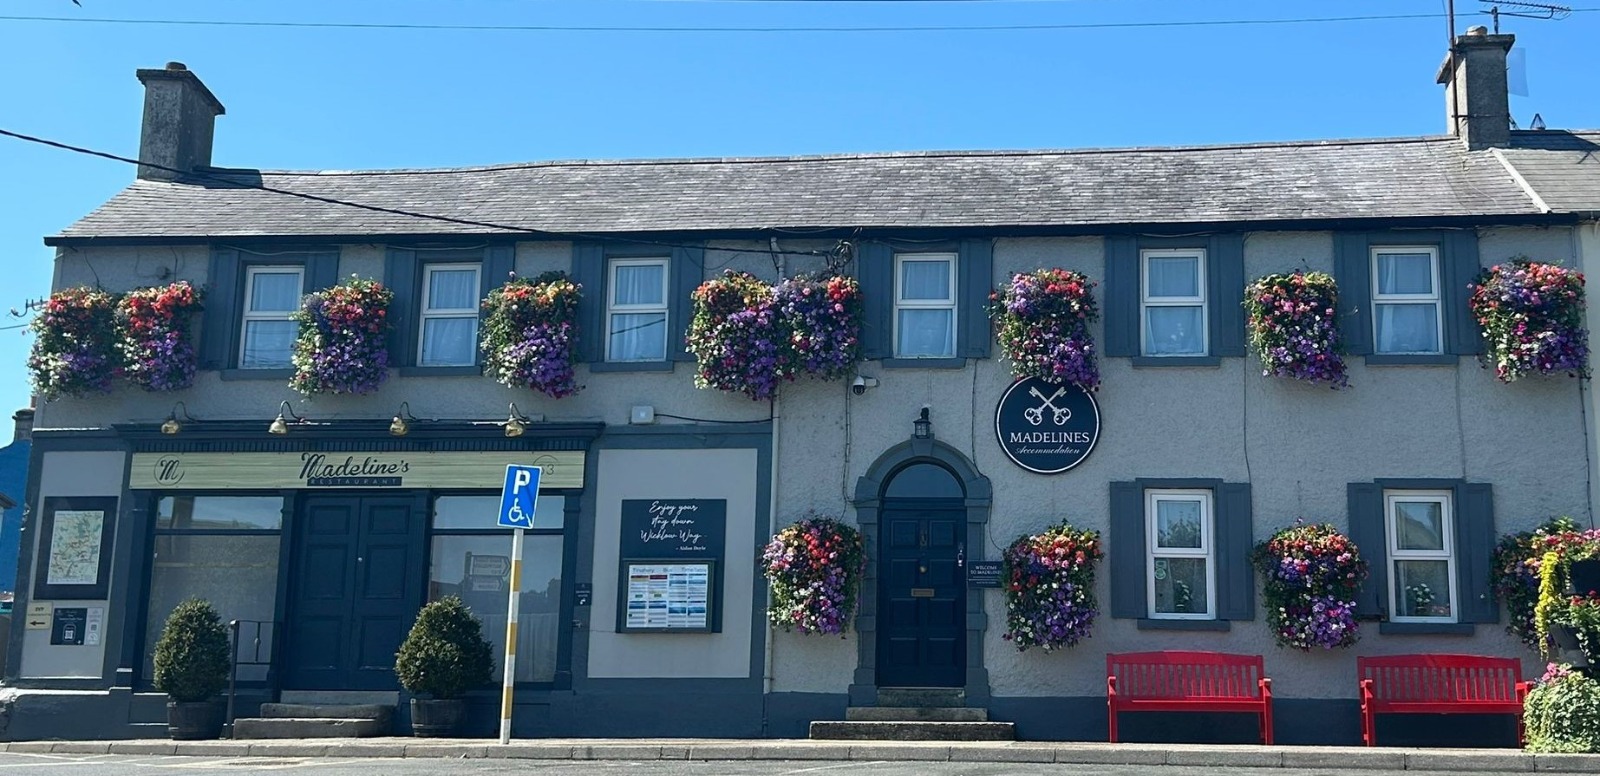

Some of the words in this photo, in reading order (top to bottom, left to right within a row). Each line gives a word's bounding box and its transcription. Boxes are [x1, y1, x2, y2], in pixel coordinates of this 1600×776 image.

[1010, 432, 1090, 443] MADELINES
[1015, 444, 1080, 454] Accommodation
[299, 452, 410, 479] Madeline's
[513, 469, 531, 495] P
[649, 501, 676, 515] Enjoy
[678, 504, 698, 515] your
[651, 515, 669, 529] stay
[671, 514, 694, 526] down
[640, 529, 677, 542] Wicklow
[679, 530, 702, 543] Way
